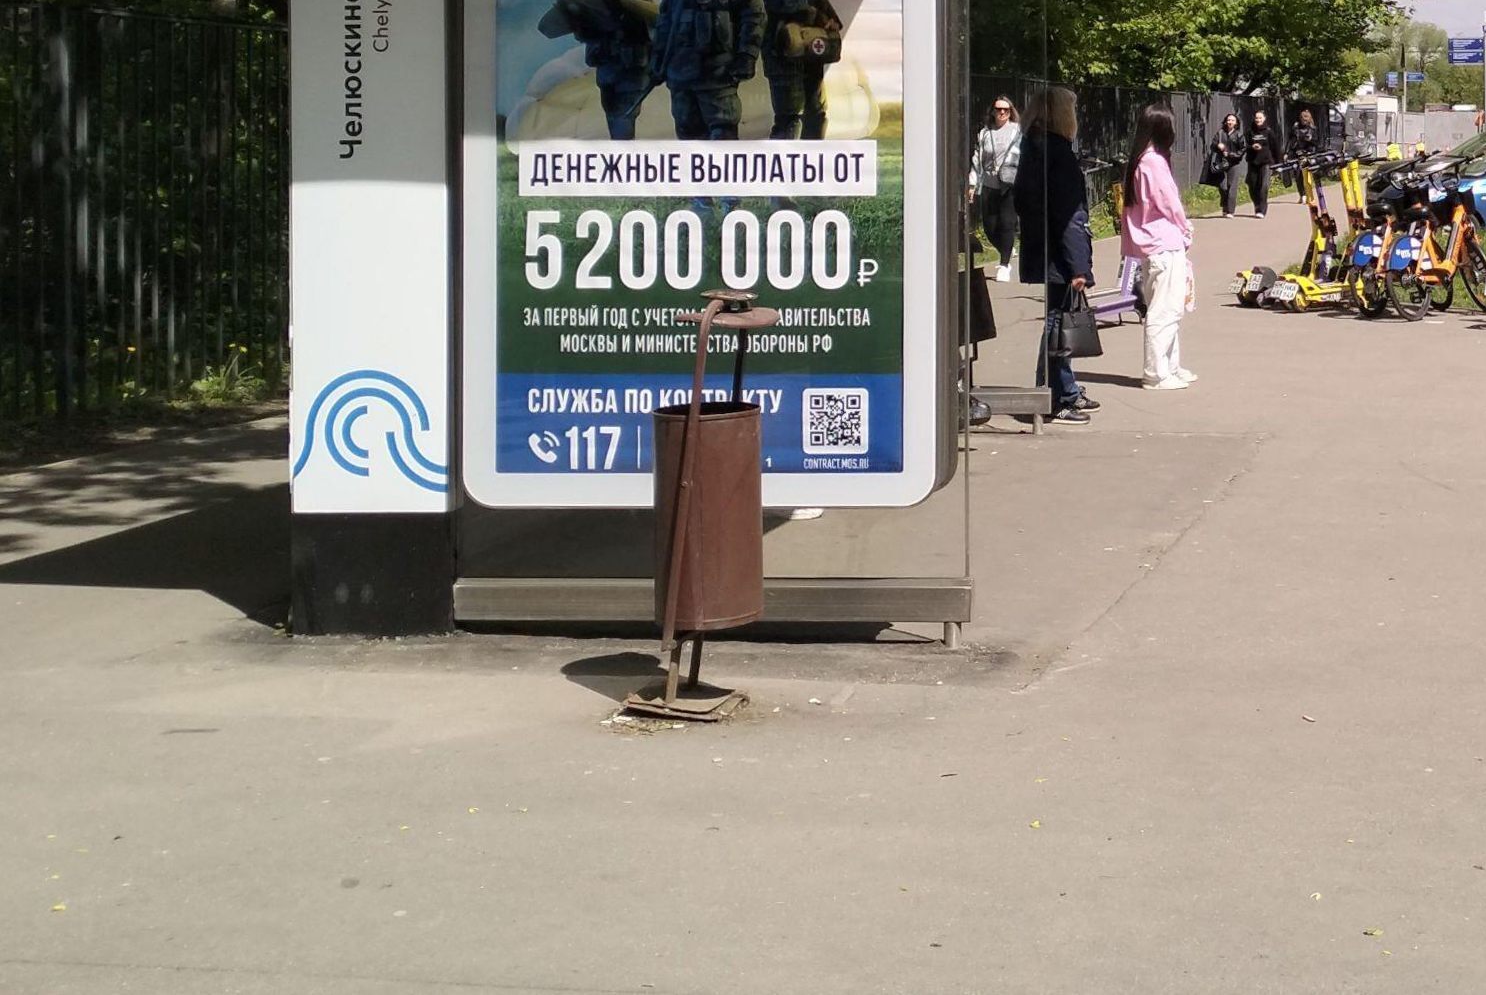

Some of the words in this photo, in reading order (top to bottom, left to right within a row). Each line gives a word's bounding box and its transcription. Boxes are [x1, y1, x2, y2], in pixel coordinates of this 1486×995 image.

[530, 153, 681, 187] ДЕНЕЖНЫЕ
[690, 153, 824, 183] ВЫПЛАТЫ
[834, 153, 865, 183] ОТ
[523, 310, 541, 327] ЗА
[544, 306, 599, 327] ПЕРВЫЙ
[603, 309, 628, 329] ГОД
[632, 309, 640, 327] С
[775, 307, 871, 327] АВИТЕЛЬСТВА
[560, 334, 618, 354] МОСКВЫ
[622, 334, 631, 353] И
[634, 334, 739, 354] МИНИСТЕСТВА
[812, 332, 833, 354] РФ
[528, 388, 618, 414] СЛУЖБА
[624, 388, 653, 414] ПО
[565, 425, 622, 470] 117
[803, 457, 870, 470] CONTRACT.MOS.RU
